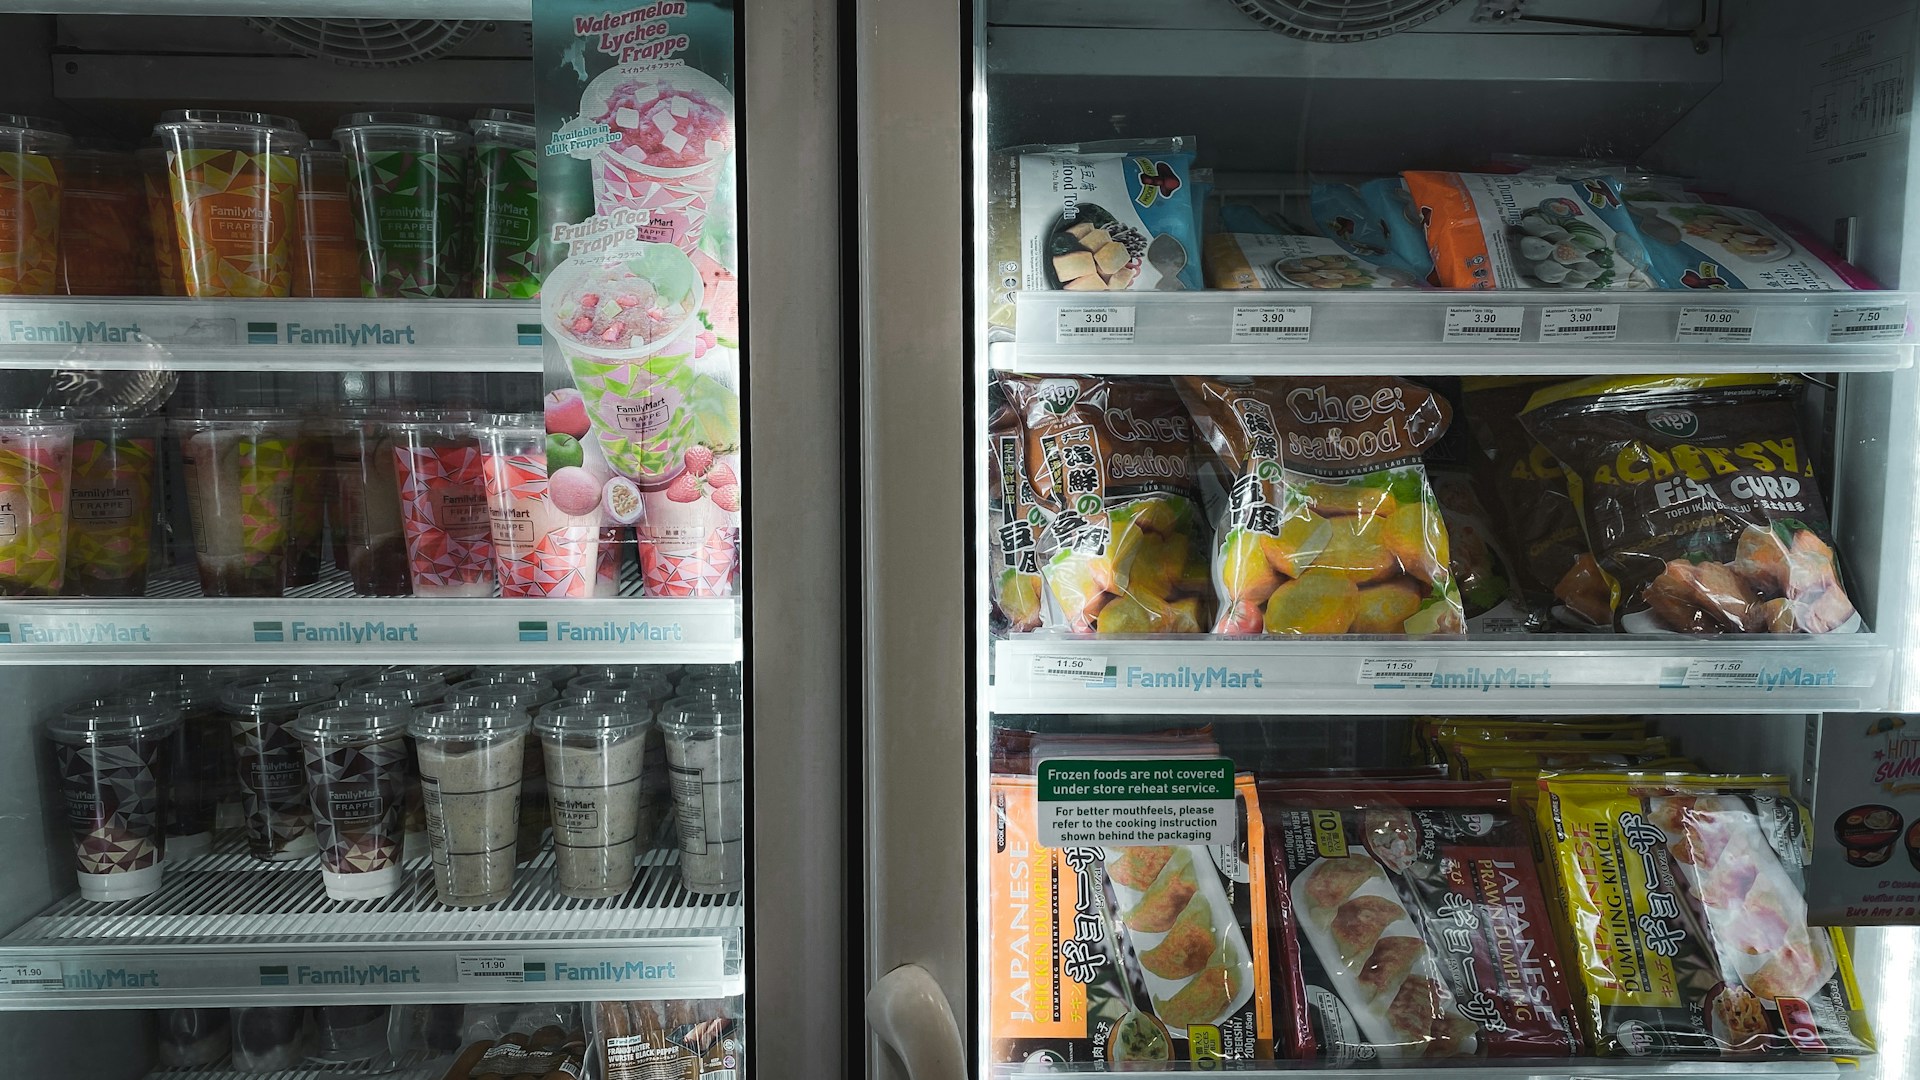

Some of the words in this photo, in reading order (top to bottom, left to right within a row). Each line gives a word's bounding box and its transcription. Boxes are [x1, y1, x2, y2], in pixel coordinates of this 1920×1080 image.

[576, 2, 686, 34] Watermelon
[600, 23, 667, 51] Lychee
[621, 37, 687, 64] Frappe
[546, 142, 569, 156] Milk
[570, 136, 604, 152] Frappe
[605, 132, 622, 143] too
[552, 127, 597, 143] Available
[599, 125, 609, 133] in
[210, 205, 273, 218] FamilyMart
[1062, 192, 1081, 220] Tofu
[219, 222, 267, 232] FRAPPE
[553, 220, 609, 242] Fruits
[611, 210, 649, 225] Tea
[570, 230, 637, 257] Frappe
[1085, 313, 1108, 323] 3.90
[1262, 313, 1284, 323] 3.90
[1474, 313, 1496, 323] 3.90
[1570, 313, 1592, 322] 3.90
[1705, 313, 1732, 323] 10.90
[1859, 312, 1880, 322] 7.50
[9, 321, 141, 343] FamilyMart
[286, 322, 415, 345] FamilyMart
[616, 397, 666, 414] FamilyMart
[1042, 384, 1075, 406] Figo
[625, 411, 662, 422] FRAPPE
[1062, 429, 1091, 444] チーズ
[1288, 416, 1402, 461] seafood
[1337, 464, 1381, 476] MAKANAN
[1384, 458, 1408, 468] LAUT
[72, 488, 129, 498] FamilyMart
[1730, 475, 1801, 499] CURD
[1665, 506, 1690, 519] TOFU
[1692, 501, 1714, 514] IKAN
[19, 622, 151, 644] FamilyMart
[292, 622, 419, 645] FamilyMart
[555, 621, 682, 644] FamilyMart
[1057, 660, 1084, 669] 11.50
[1386, 662, 1413, 671] 11.50
[1714, 663, 1742, 671] 11.50
[1126, 667, 1263, 692] FamilyMart
[1428, 667, 1552, 692] amilyMart
[1048, 769, 1091, 781] Frozen
[1094, 768, 1128, 780] foods
[1131, 771, 1151, 780] are
[1154, 769, 1174, 780] not
[1176, 767, 1225, 780] covered
[328, 787, 381, 800] FamilyMart
[1053, 784, 1091, 795] under
[1093, 784, 1125, 795] store
[1128, 782, 1169, 794] reheat
[1171, 782, 1219, 794] service.
[336, 801, 376, 811] FRAPPE
[558, 811, 591, 820] FRAPPE
[1055, 806, 1074, 816] For
[1077, 806, 1110, 816] better
[1112, 805, 1177, 817] mouthfeels,
[1180, 805, 1215, 818] please
[1052, 819, 1080, 829] refer
[1083, 819, 1093, 829] to
[1096, 819, 1113, 829] the
[1115, 817, 1157, 832] cooking
[1159, 817, 1218, 829] instruction
[1291, 811, 1303, 834] BERAT
[1301, 811, 1311, 824] NET
[1319, 811, 1338, 833] 10
[1060, 831, 1096, 841] shown
[1098, 831, 1135, 841] behind
[1137, 829, 1155, 840] the
[1157, 829, 1212, 843] packaging
[1657, 849, 1675, 888] gyoza
[1093, 867, 1105, 909] gyoza
[1619, 811, 1687, 957] ギョーザ
[1009, 839, 1034, 1023] JAPANESE
[1478, 859, 1504, 921] PRAWN
[1494, 926, 1532, 1022] DUMPLING
[1492, 860, 1555, 1024] JAPANESE
[17, 968, 42, 976] 11.90
[480, 961, 505, 969] 11.90
[555, 960, 676, 983] FamilyMart
[1436, 892, 1507, 1034] ギョーザ
[63, 965, 158, 988] milyMart
[296, 964, 420, 985] FamilyMart
[1034, 943, 1051, 1024] CHICKEN
[1655, 960, 1674, 999] キムチ
[1069, 984, 1083, 1022] チキン
[635, 1050, 655, 1060] BLACK
[656, 1046, 680, 1057] PEPPER
[1244, 1037, 1256, 1059] 200g
